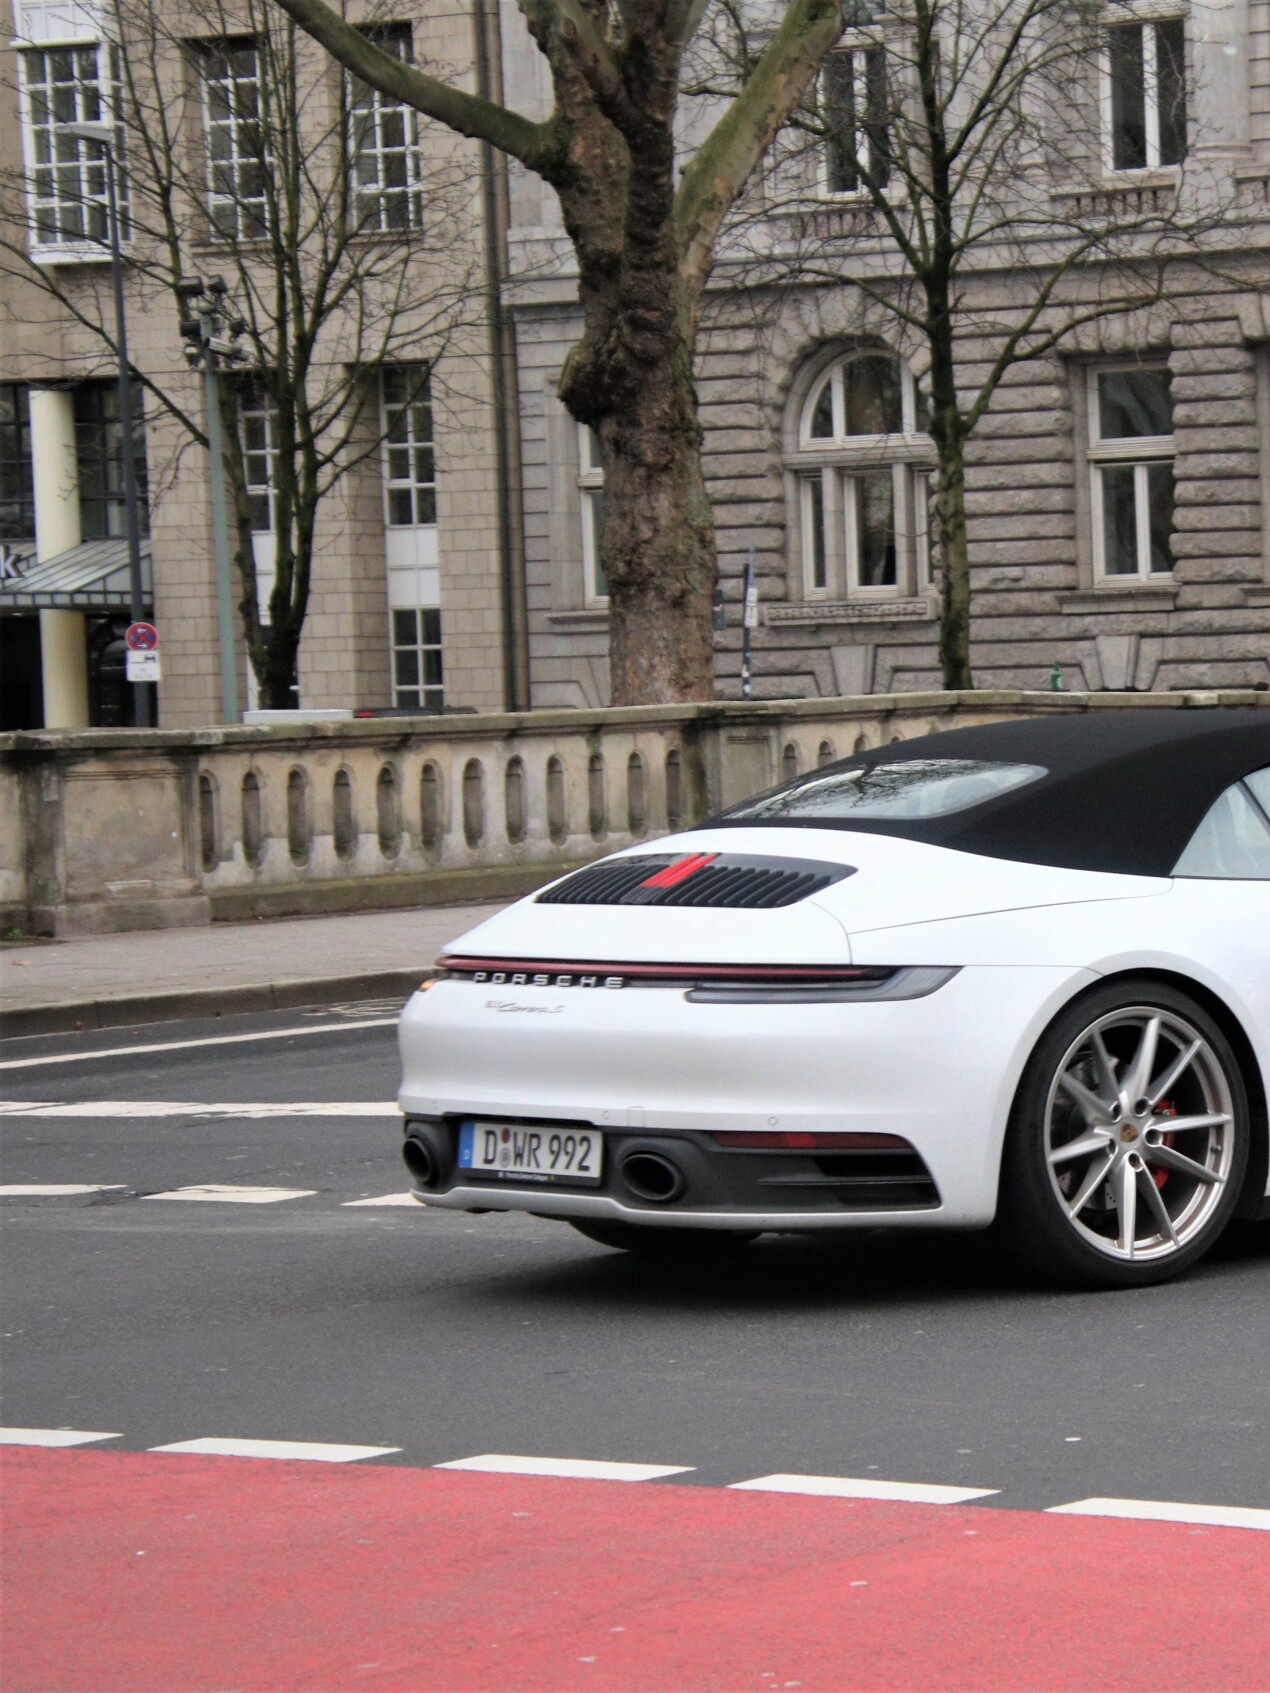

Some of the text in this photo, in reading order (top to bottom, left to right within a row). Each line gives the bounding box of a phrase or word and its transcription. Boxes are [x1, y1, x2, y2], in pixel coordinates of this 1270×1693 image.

[473, 971, 624, 989] PORSCHE
[483, 1129, 592, 1172] D WR 992
